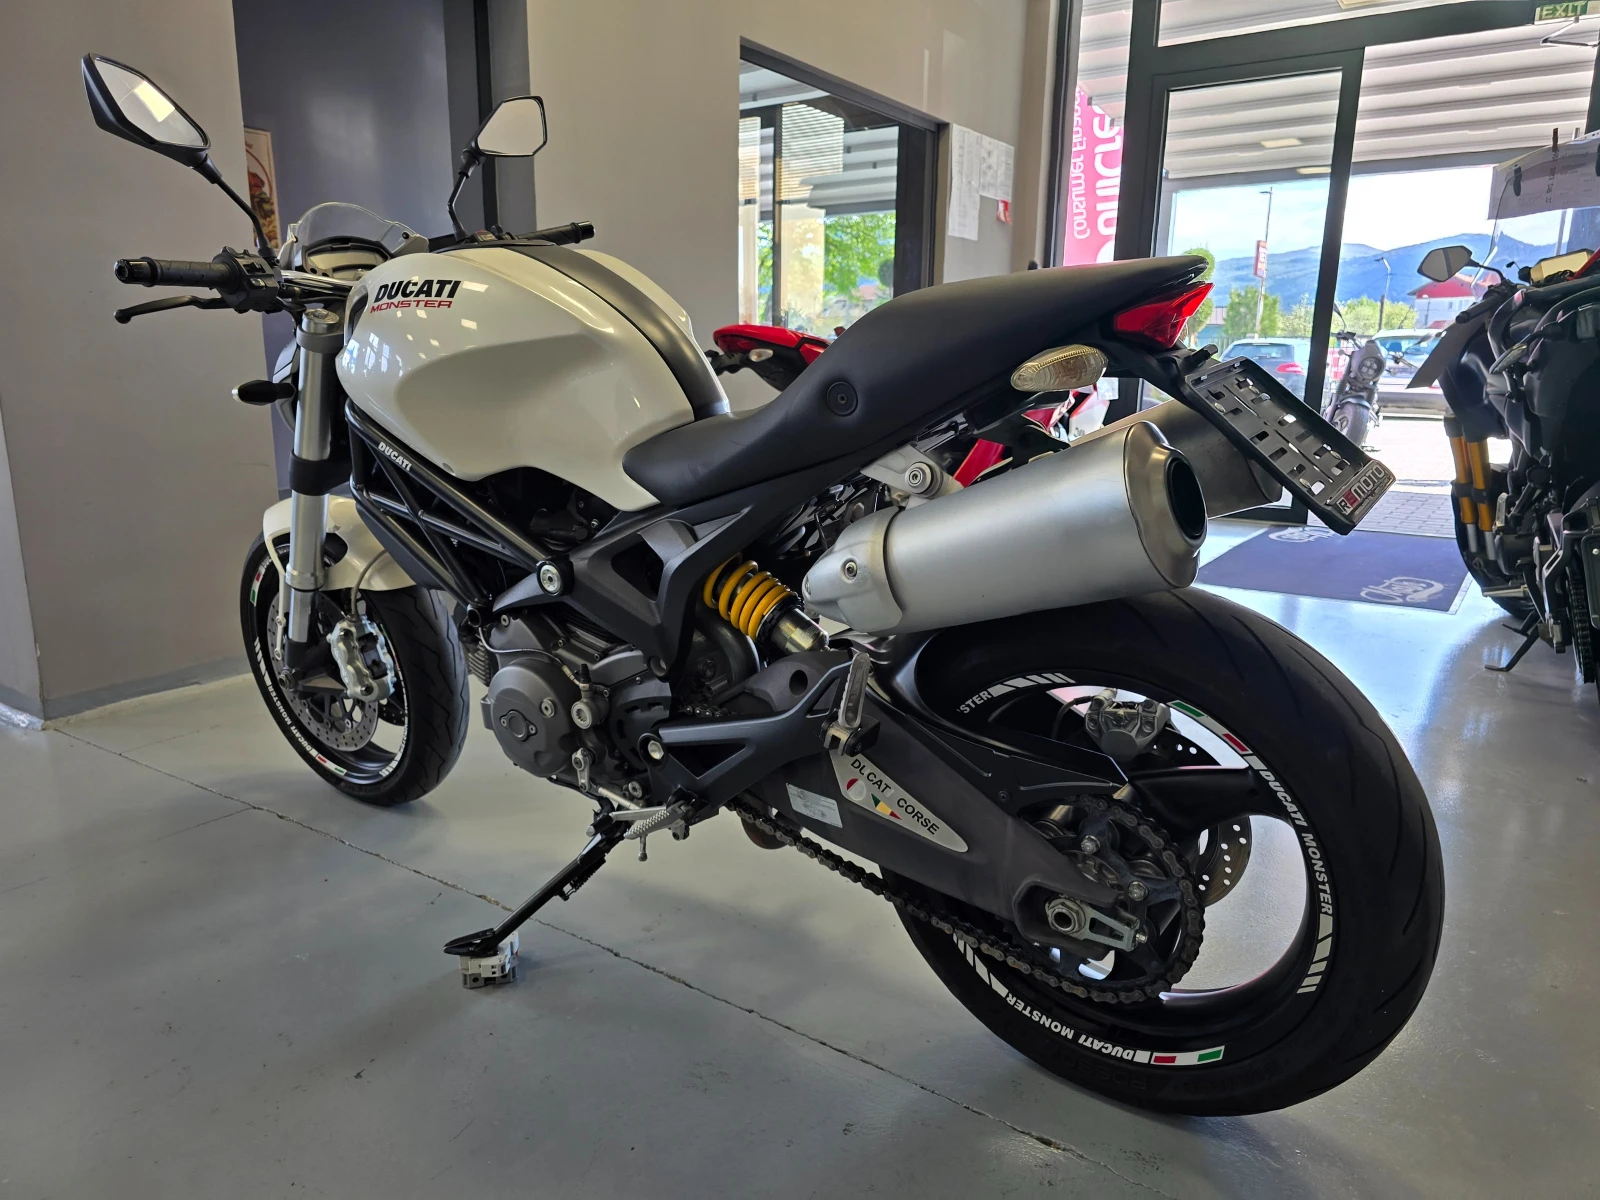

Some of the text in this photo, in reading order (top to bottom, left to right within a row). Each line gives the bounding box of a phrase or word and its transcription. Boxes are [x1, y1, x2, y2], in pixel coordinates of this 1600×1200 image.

[1541, 1, 1587, 19] EXIT
[374, 280, 461, 303] DUCATI
[370, 300, 453, 313] MONSTER
[378, 442, 412, 471] DUCATI
[957, 690, 992, 714] STER
[268, 686, 312, 752] DUCATI MONSTER
[897, 798, 940, 835] CORSE
[1259, 770, 1333, 915] DUCATI MONSTER
[1006, 992, 1135, 1062] DUCATI MONSTER
